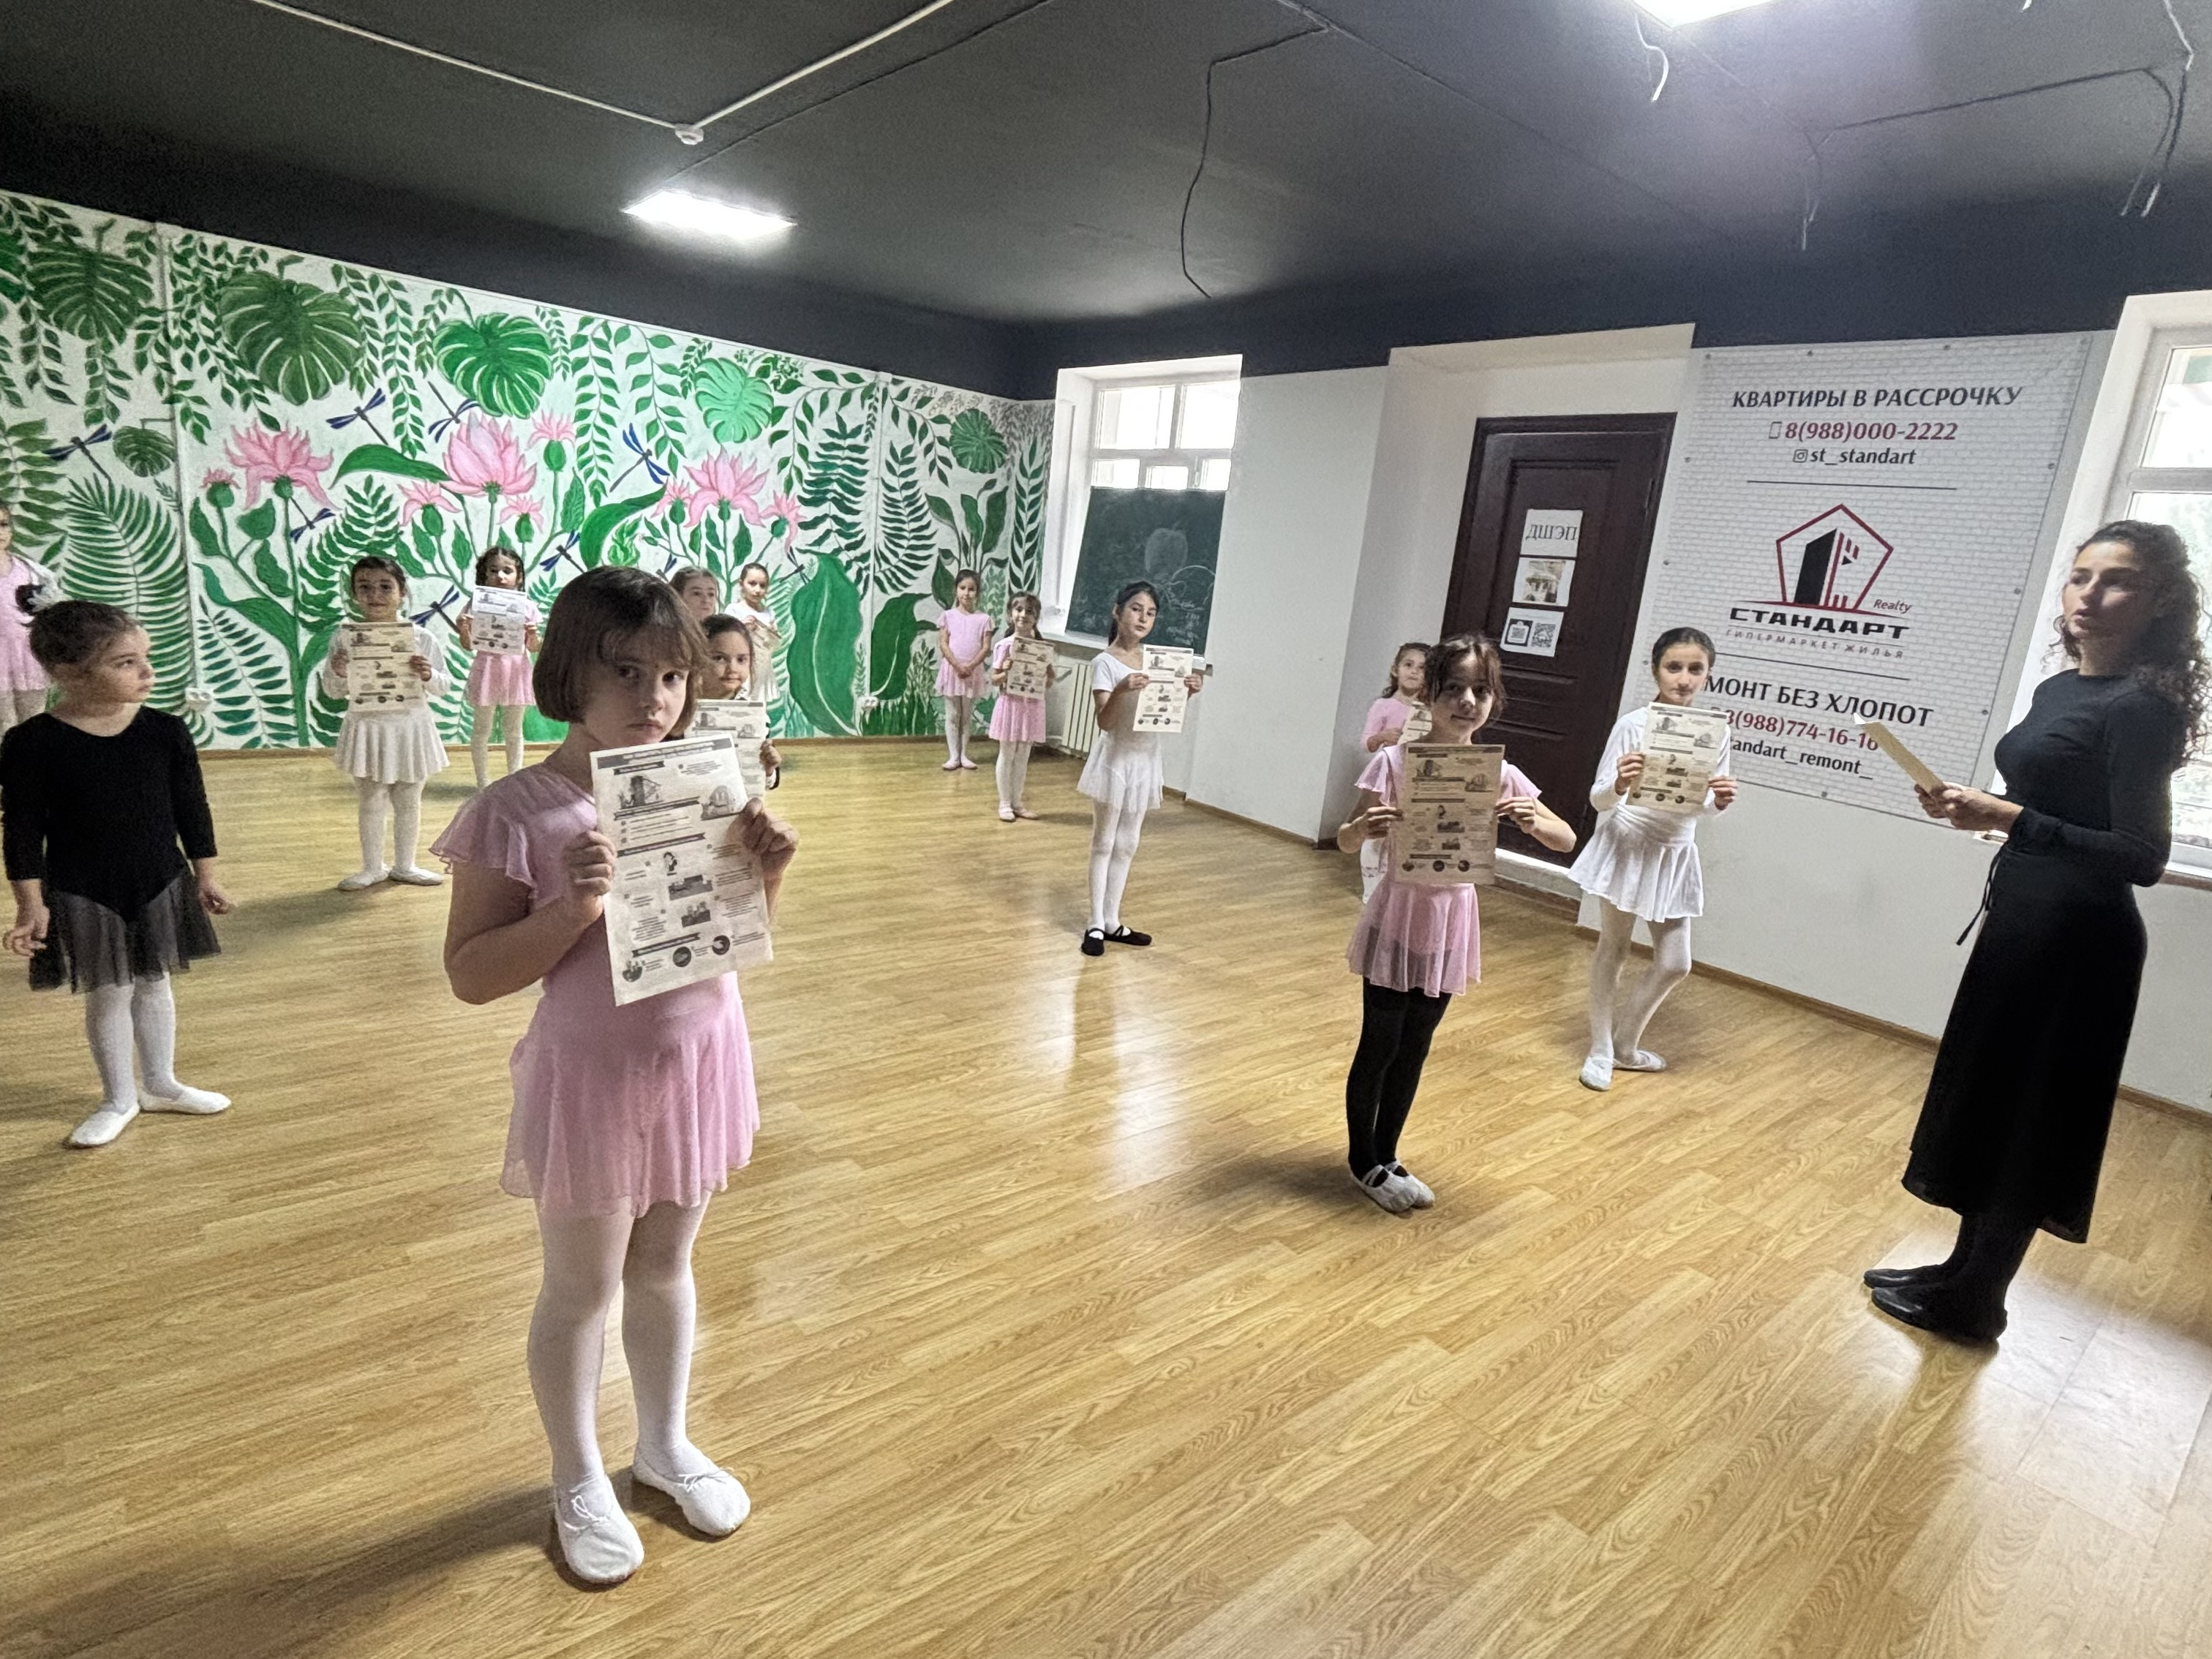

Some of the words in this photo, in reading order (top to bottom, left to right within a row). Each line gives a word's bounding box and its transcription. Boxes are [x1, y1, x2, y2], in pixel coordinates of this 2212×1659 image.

[1732, 390, 1846, 407] КВАРТИРЫ
[1853, 389, 1867, 407] В
[1873, 387, 2022, 407] РАССРОЧКУ
[1785, 421, 1958, 443] 8(988)000-2222
[1810, 448, 1916, 465] st_standart
[1525, 524, 1577, 541] ДШЭП
[1873, 599, 1912, 614] Realty
[1729, 607, 1910, 639] СТАНДАРТ
[1726, 629, 1840, 650] ГИПЕРМАРКЕТ
[1845, 644, 1903, 658] ЖИЛЬЯ
[1704, 675, 1772, 701] МОНТ
[1777, 686, 1818, 708] БЕЗ
[1824, 693, 1934, 726] ХЛОПОТ
[1731, 736, 1873, 780] andart_remont_
